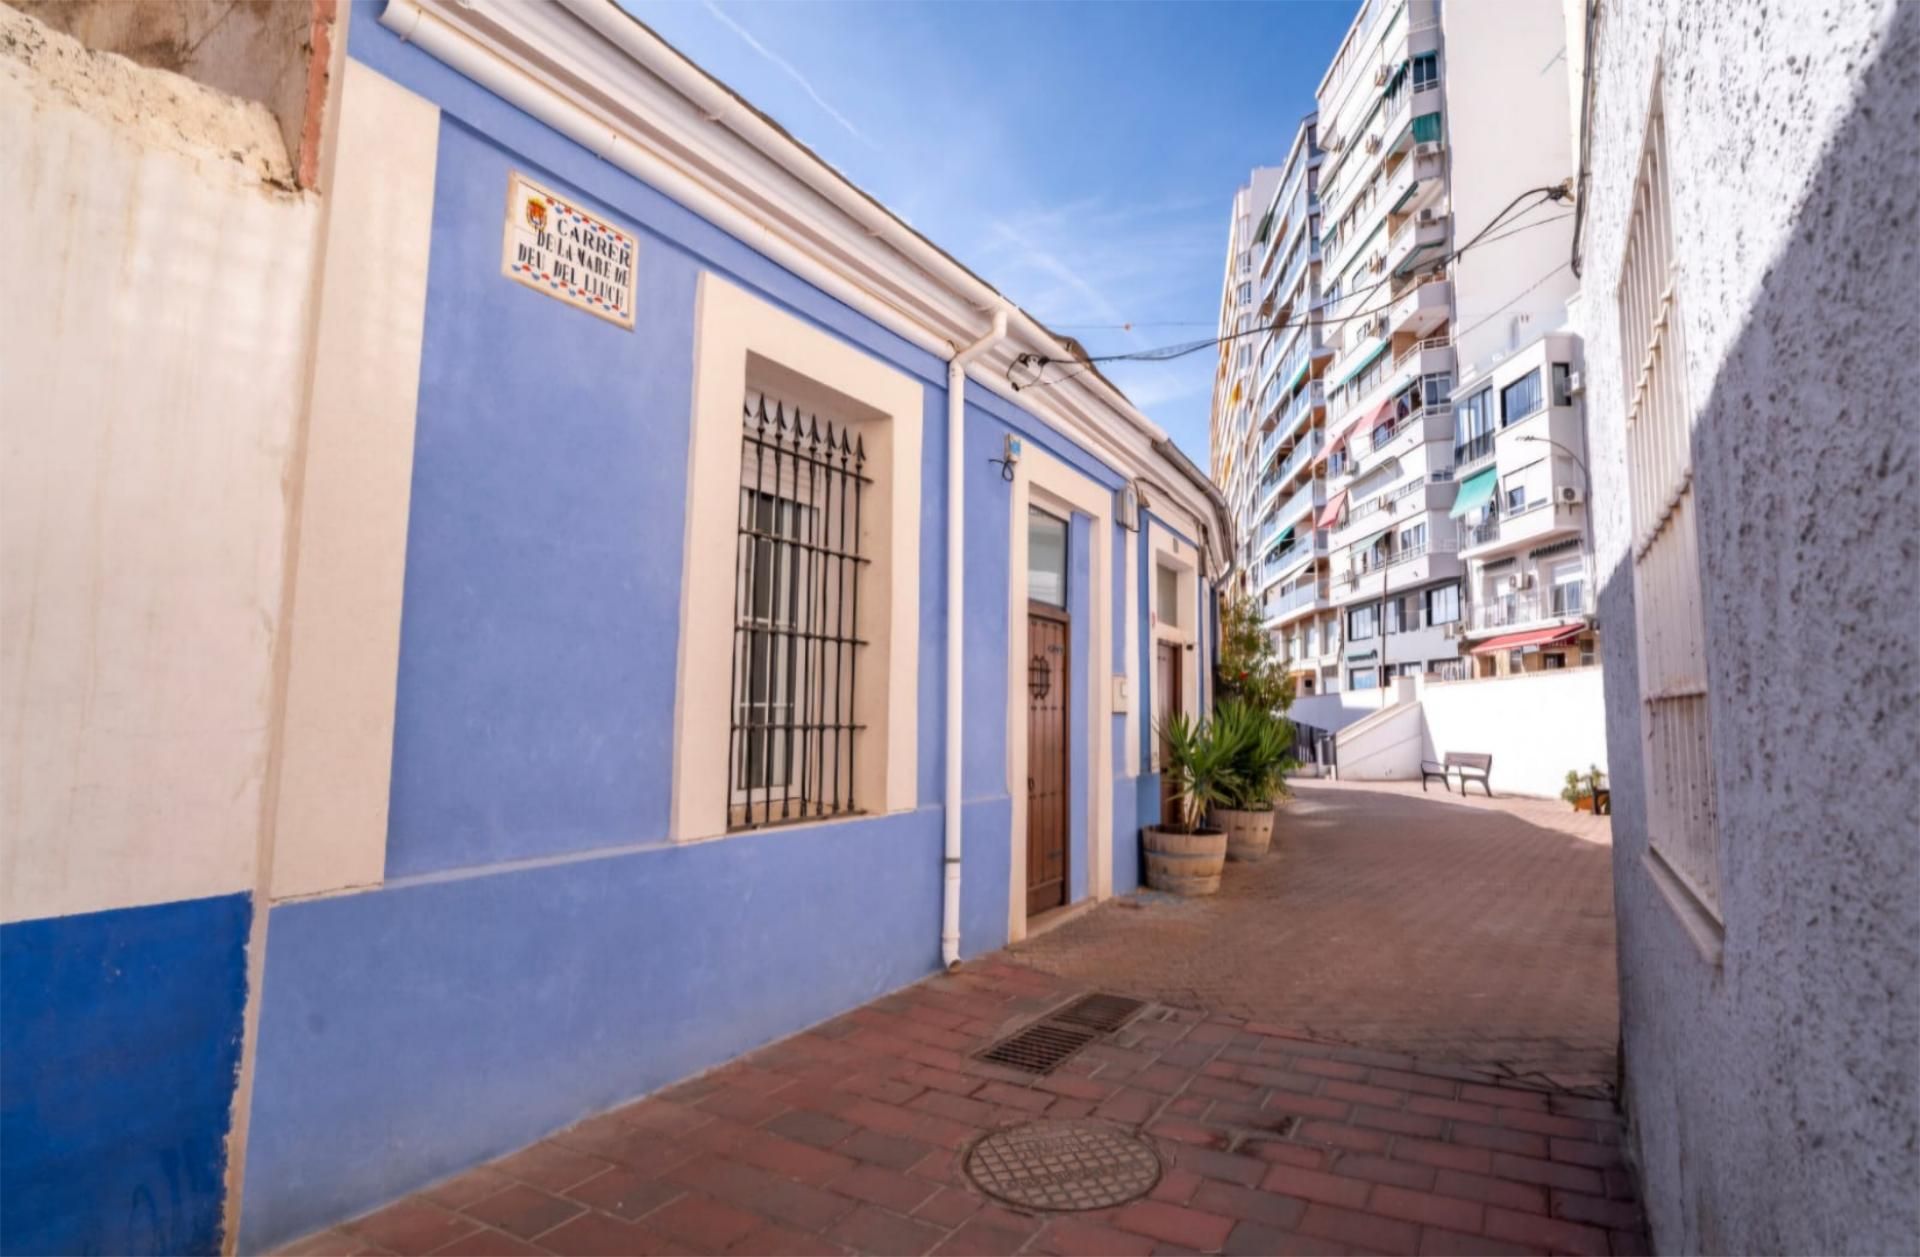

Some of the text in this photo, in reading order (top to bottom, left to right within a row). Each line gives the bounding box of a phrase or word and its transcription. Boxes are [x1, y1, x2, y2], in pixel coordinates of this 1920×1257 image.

[518, 243, 546, 271] DEU
[554, 260, 577, 286] DEL
[537, 230, 629, 288] DE LA MARE DE
[557, 219, 631, 267] CARRER
